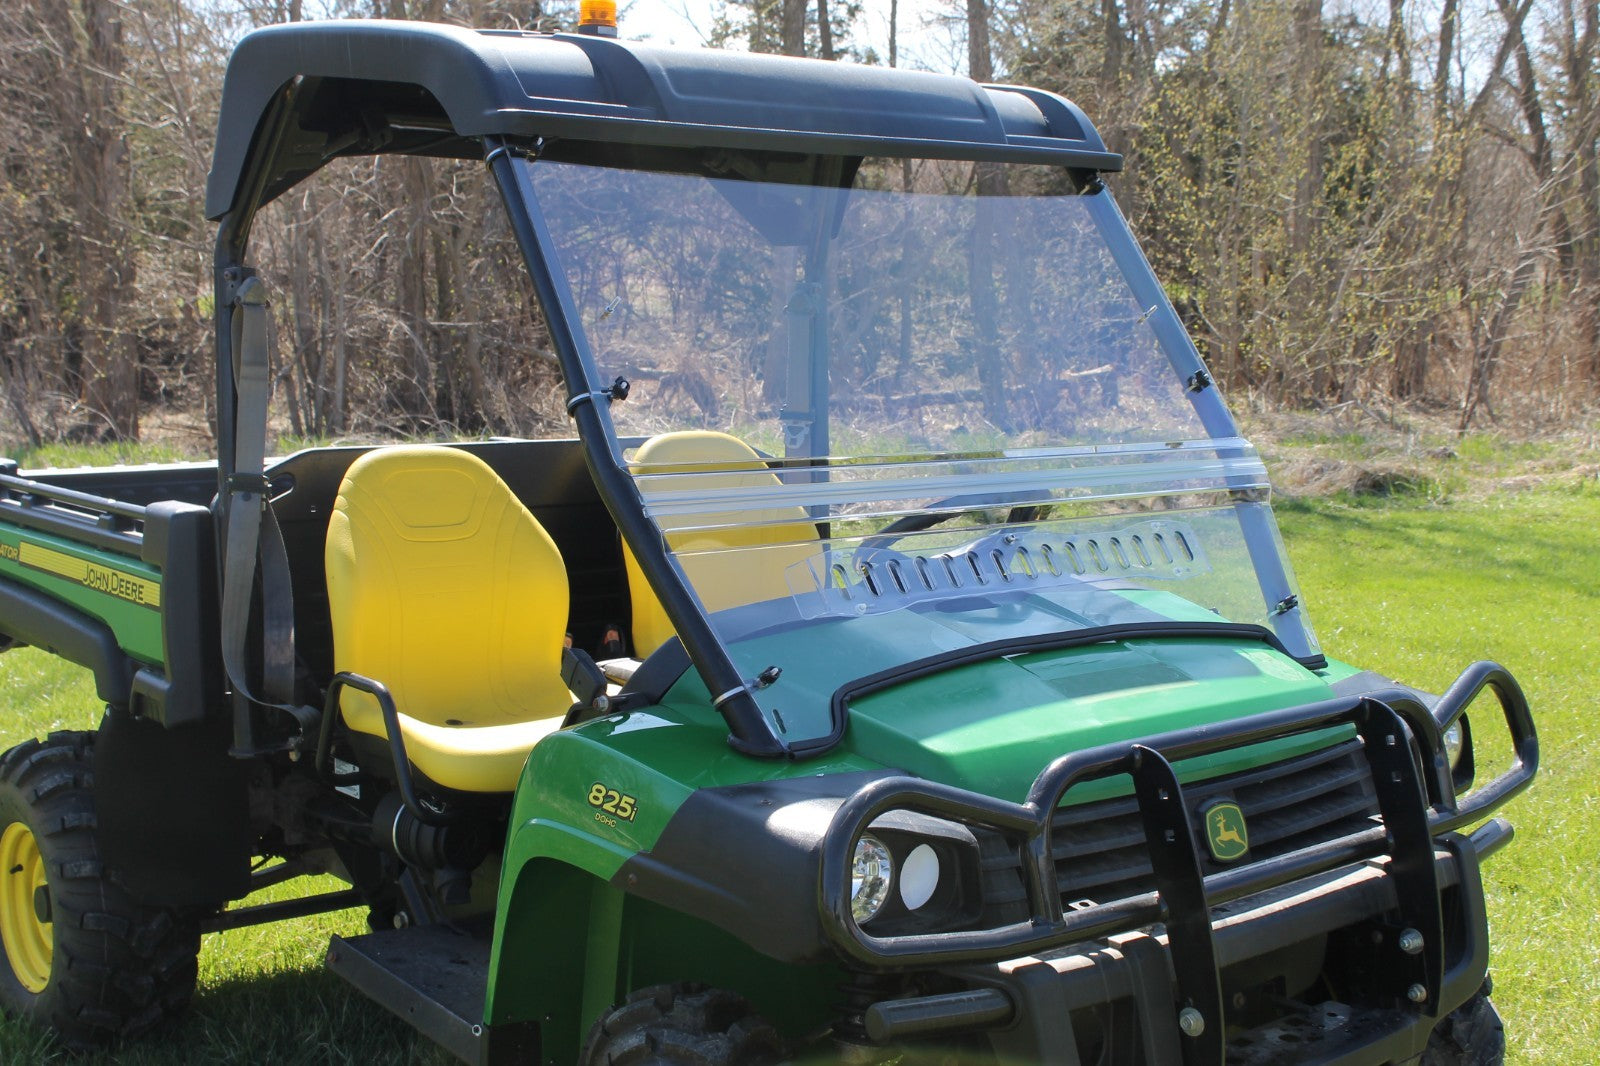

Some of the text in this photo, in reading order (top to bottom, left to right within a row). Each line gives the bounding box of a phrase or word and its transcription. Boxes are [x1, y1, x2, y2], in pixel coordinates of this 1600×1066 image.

[82, 564, 145, 601] JOHN DEERE
[588, 783, 637, 821] 825i
[595, 812, 616, 827] DOHC
